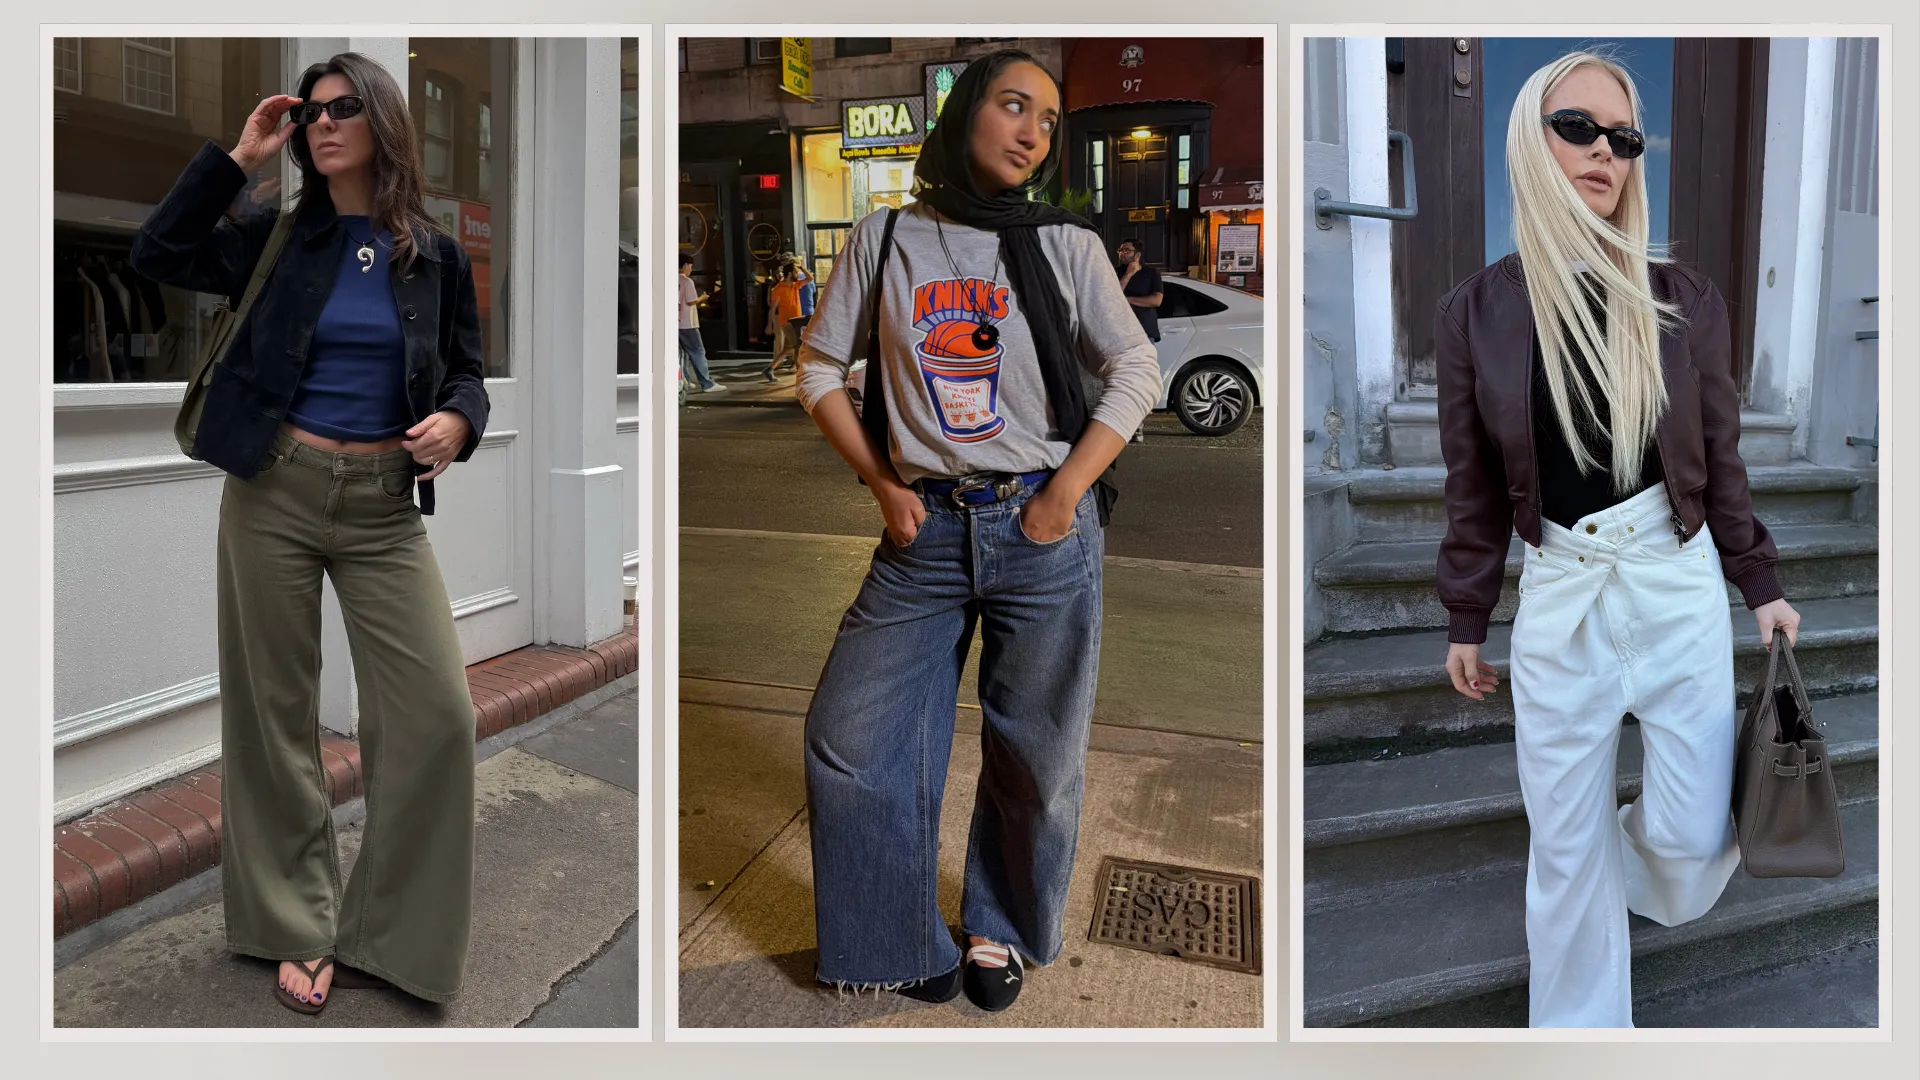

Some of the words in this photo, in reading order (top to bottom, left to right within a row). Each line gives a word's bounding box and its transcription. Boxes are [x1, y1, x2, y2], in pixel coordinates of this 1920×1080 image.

[1122, 79, 1142, 93] 97
[848, 103, 914, 138] BORA
[872, 146, 897, 155] Smoothie
[1212, 190, 1224, 200] 97
[913, 279, 1010, 325] KNICKS
[1132, 893, 1211, 930] GAS
